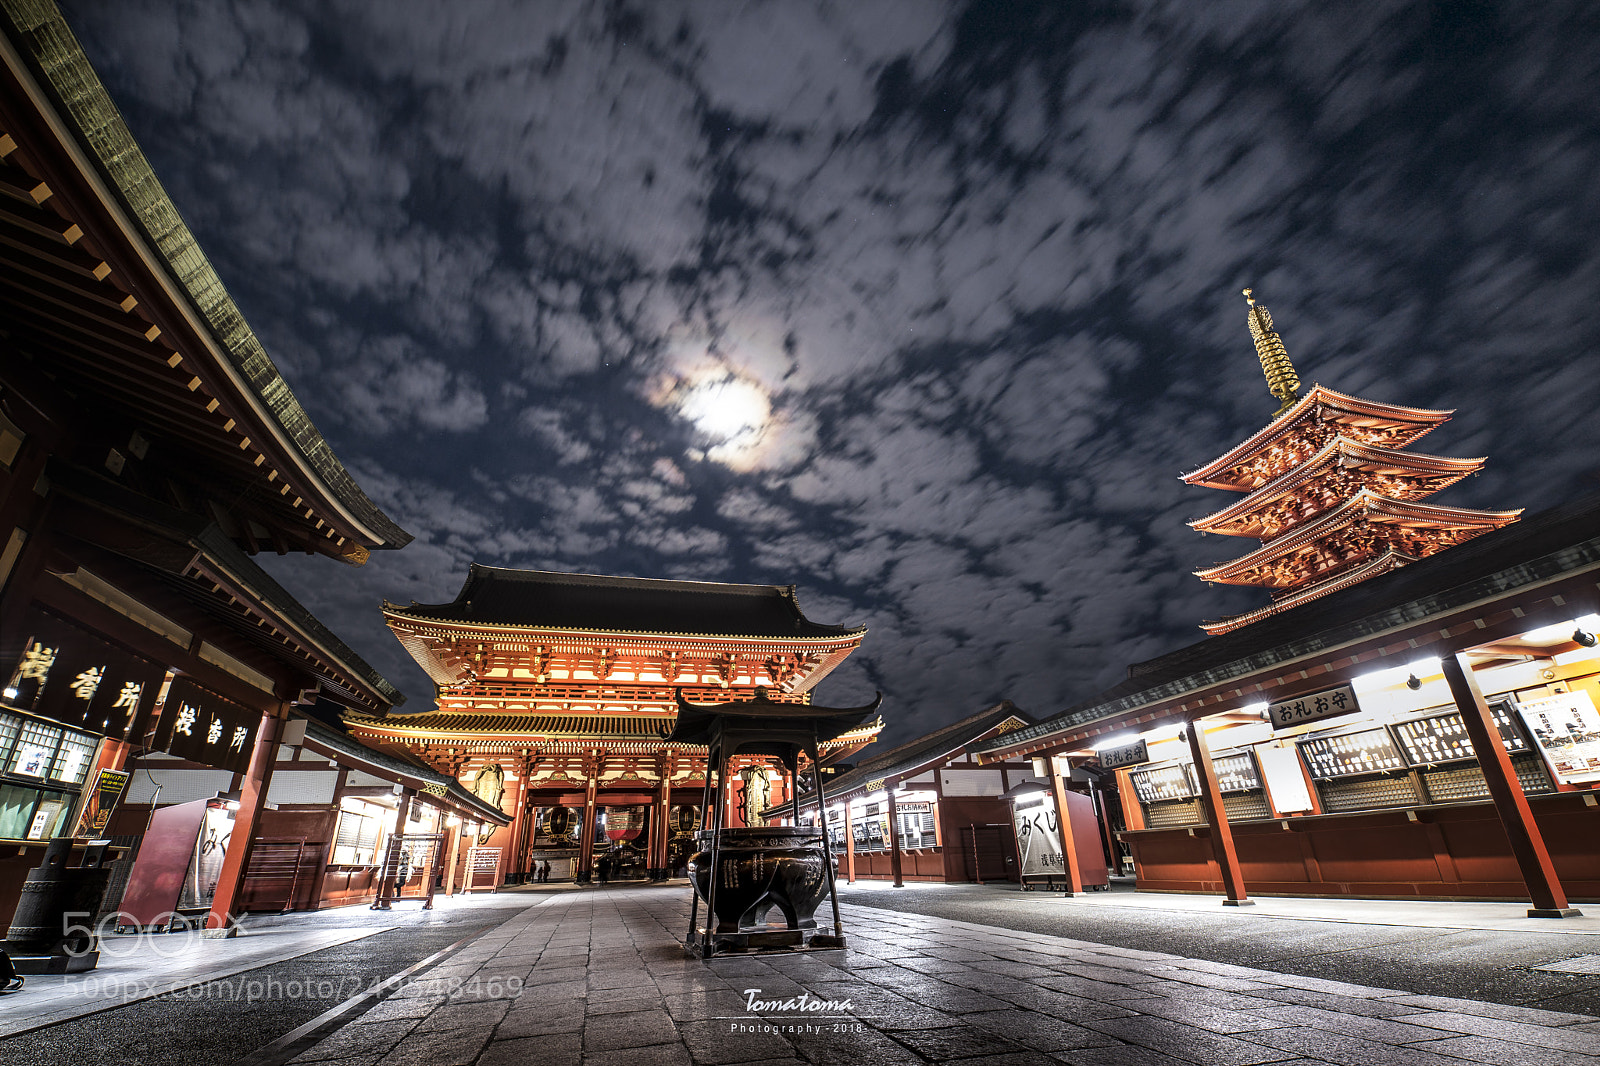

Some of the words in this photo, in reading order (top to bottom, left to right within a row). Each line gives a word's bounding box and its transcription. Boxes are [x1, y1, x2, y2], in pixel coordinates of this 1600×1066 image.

[1279, 692, 1347, 722] お札お守
[1104, 745, 1143, 766] お札お守
[1021, 809, 1057, 837] みくじ
